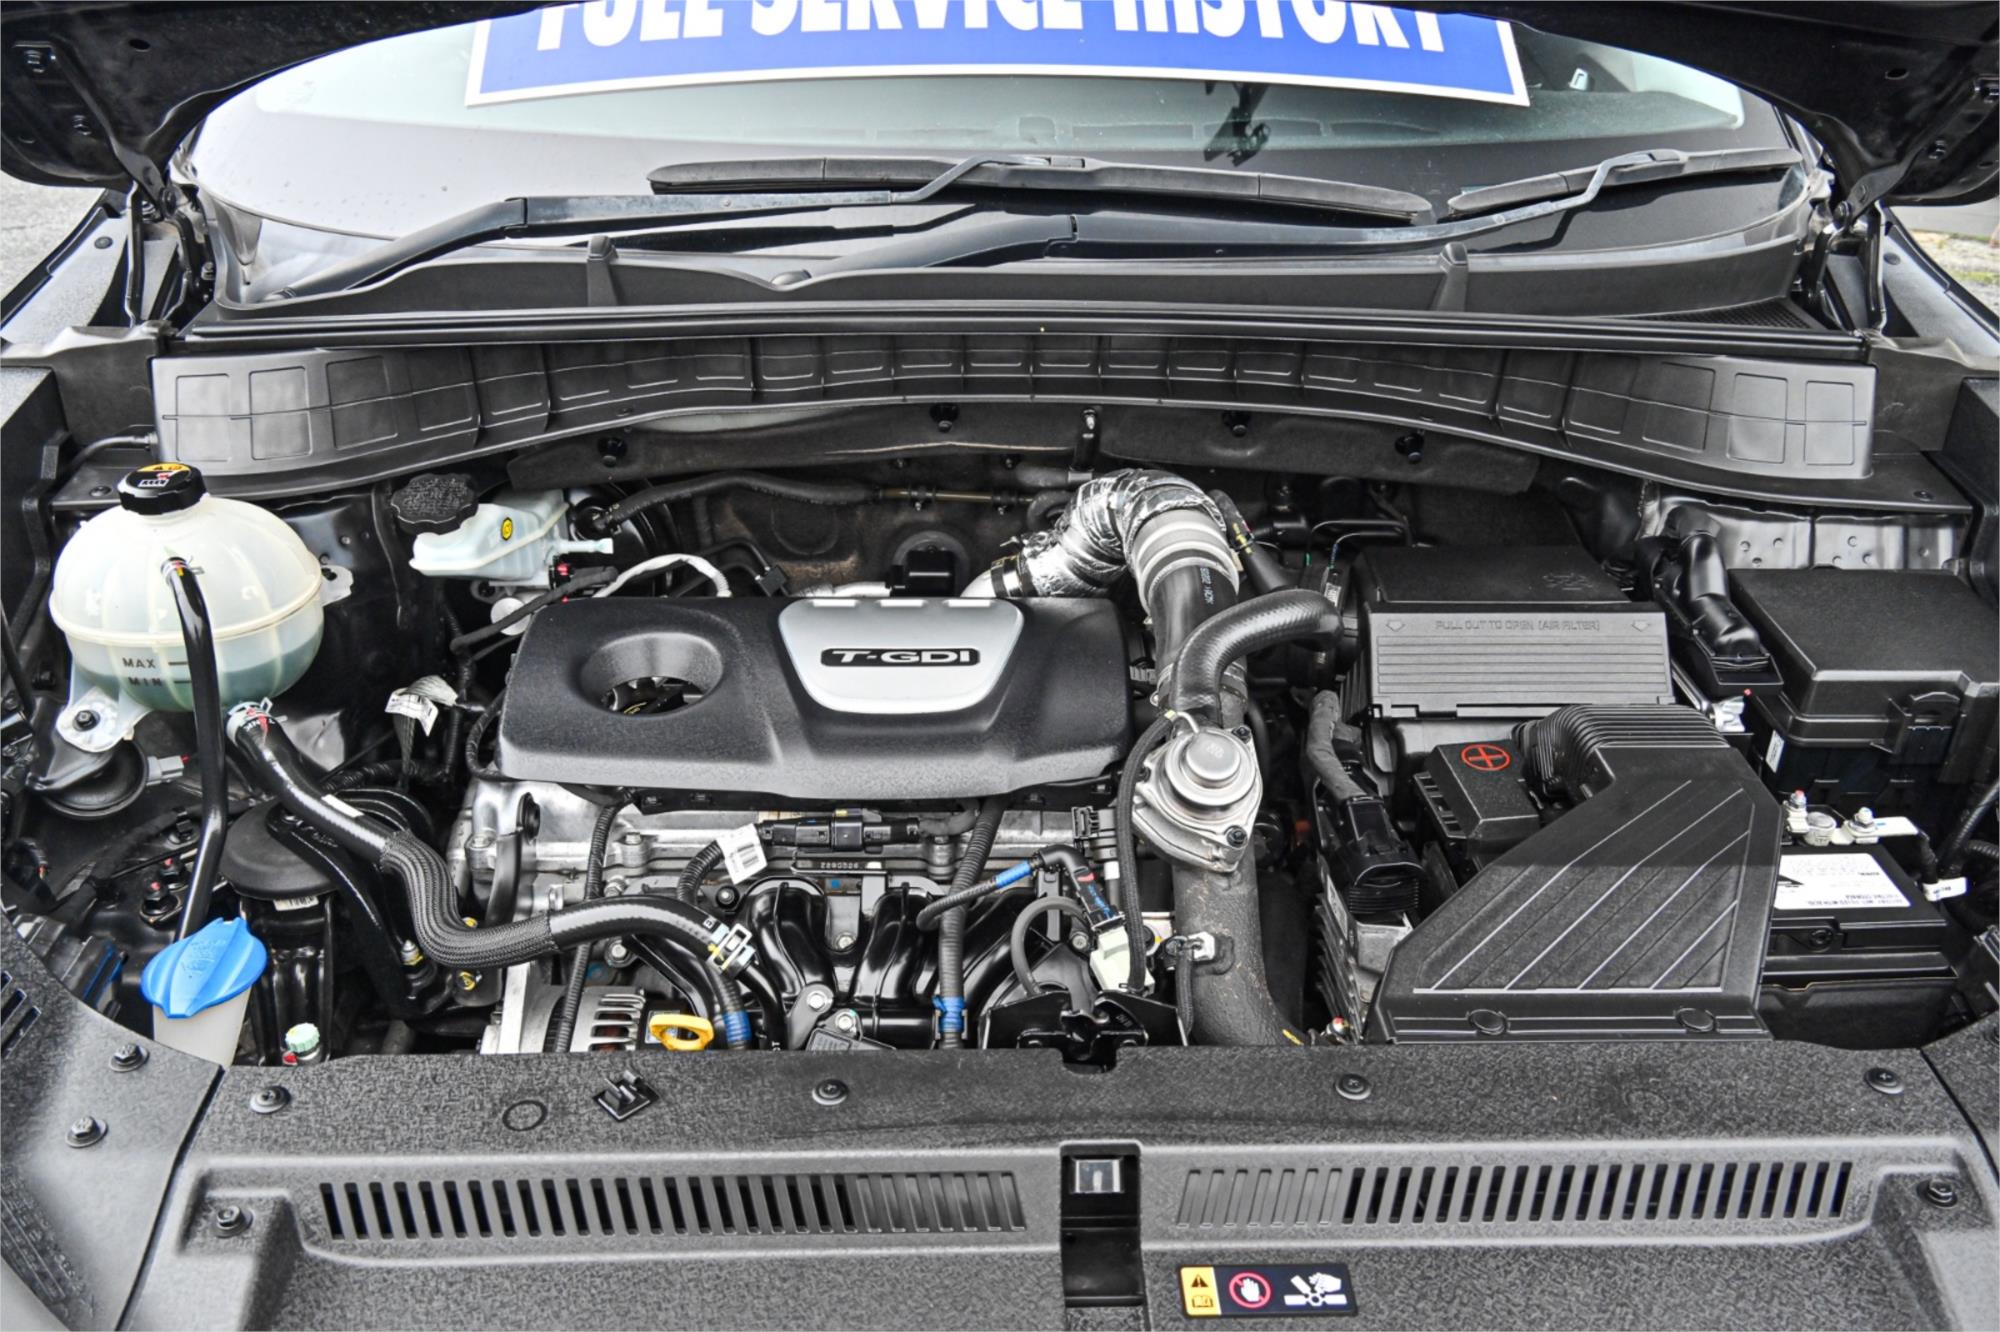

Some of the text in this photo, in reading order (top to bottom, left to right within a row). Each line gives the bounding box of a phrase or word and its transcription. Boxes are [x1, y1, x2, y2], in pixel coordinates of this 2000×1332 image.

[1435, 620, 1463, 630] PULL
[1465, 620, 1487, 630] OUT
[1488, 620, 1502, 630] TO
[1505, 620, 1534, 630] OPEN
[832, 650, 970, 663] T-GDI
[122, 657, 155, 668] MAX
[128, 677, 162, 686] MIN
